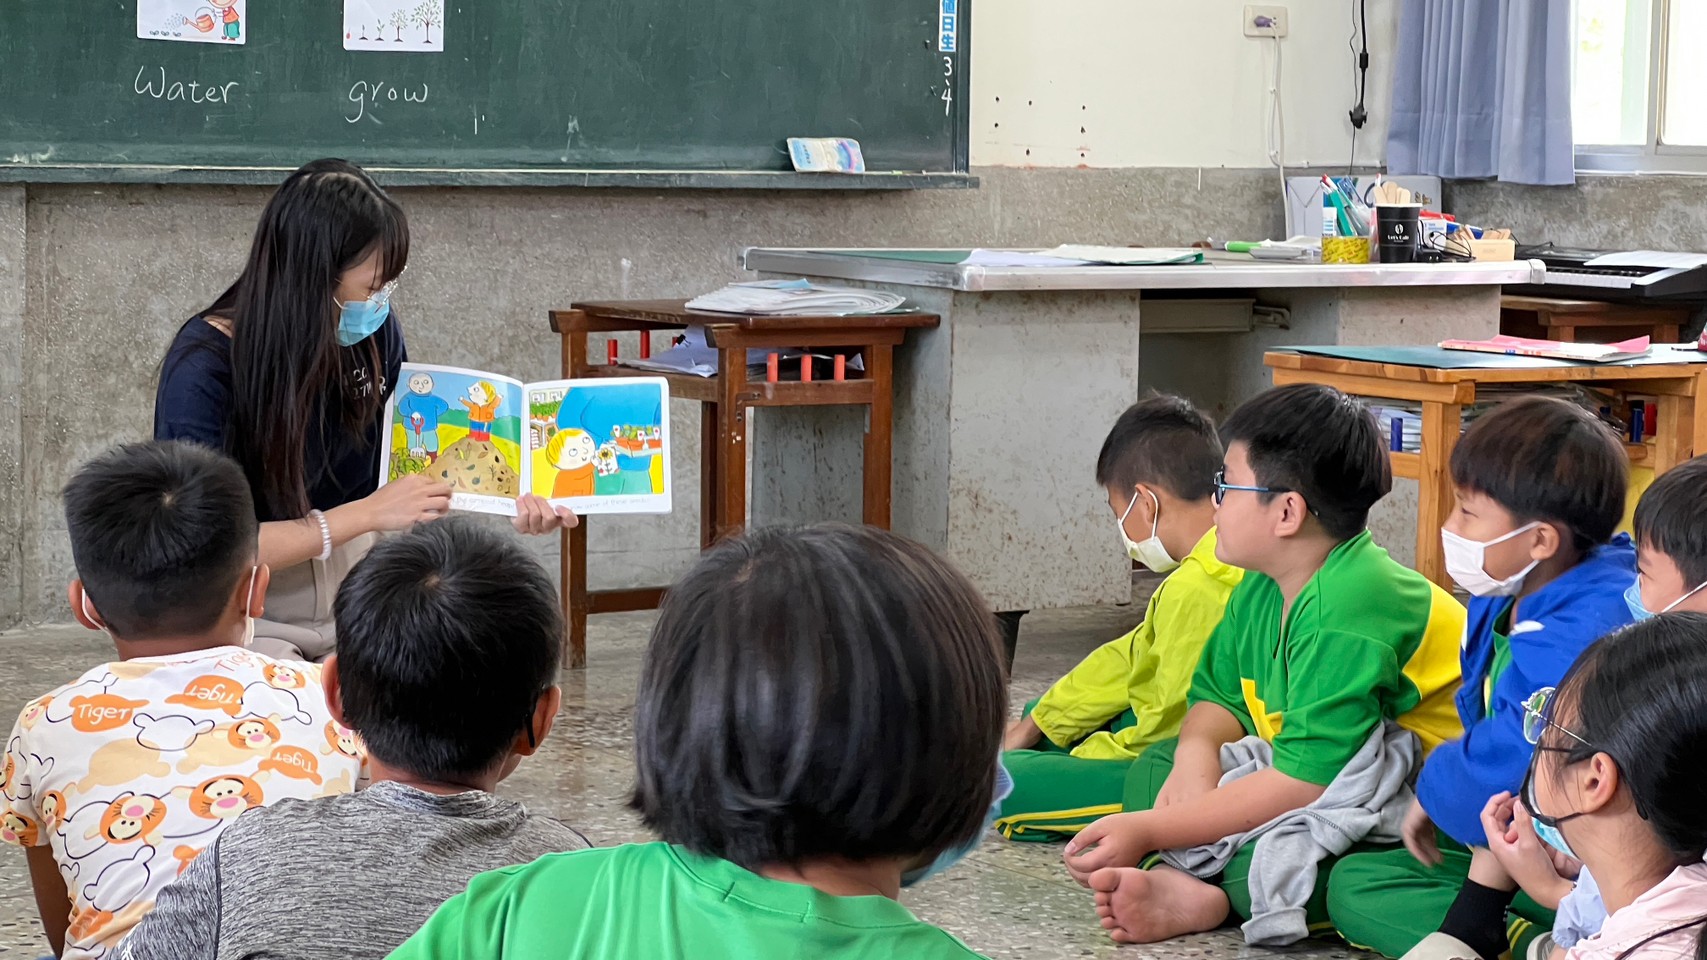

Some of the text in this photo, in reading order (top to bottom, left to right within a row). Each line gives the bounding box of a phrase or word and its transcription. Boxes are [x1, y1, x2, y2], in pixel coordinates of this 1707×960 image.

[134, 65, 239, 104] Water
[345, 80, 429, 123] grow
[184, 683, 235, 704] Tiger
[78, 703, 131, 726] Tiger
[271, 751, 315, 774] Tiger
